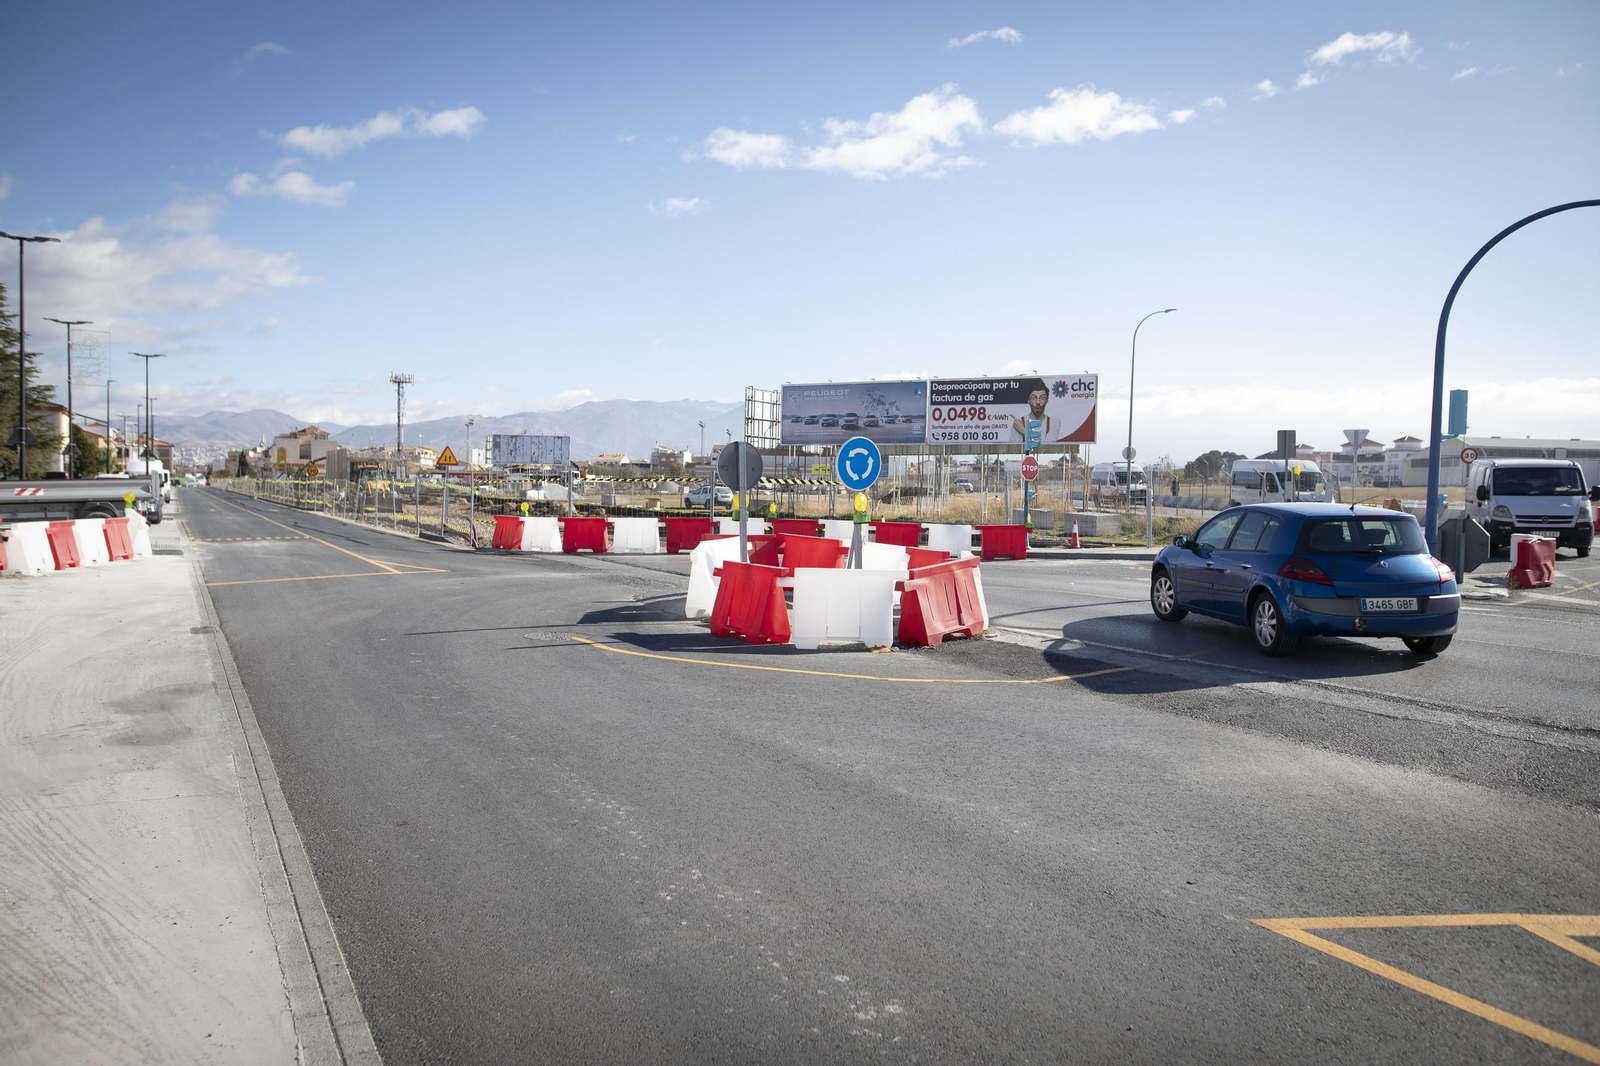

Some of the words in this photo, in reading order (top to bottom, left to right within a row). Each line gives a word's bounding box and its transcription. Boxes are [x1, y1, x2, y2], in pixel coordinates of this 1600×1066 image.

[932, 381, 990, 392] Despreocúpate
[992, 382, 1007, 391] por
[1010, 380, 1019, 388] tu
[1071, 378, 1094, 392] chc
[932, 394, 962, 402] factura
[964, 393, 976, 401] de
[978, 394, 994, 403] gas
[932, 406, 986, 424] 0,0498
[941, 432, 959, 440] 958
[962, 432, 978, 440] 010
[982, 432, 998, 440] 801
[1368, 600, 1394, 610] 3465
[1396, 600, 1414, 609] GBF
